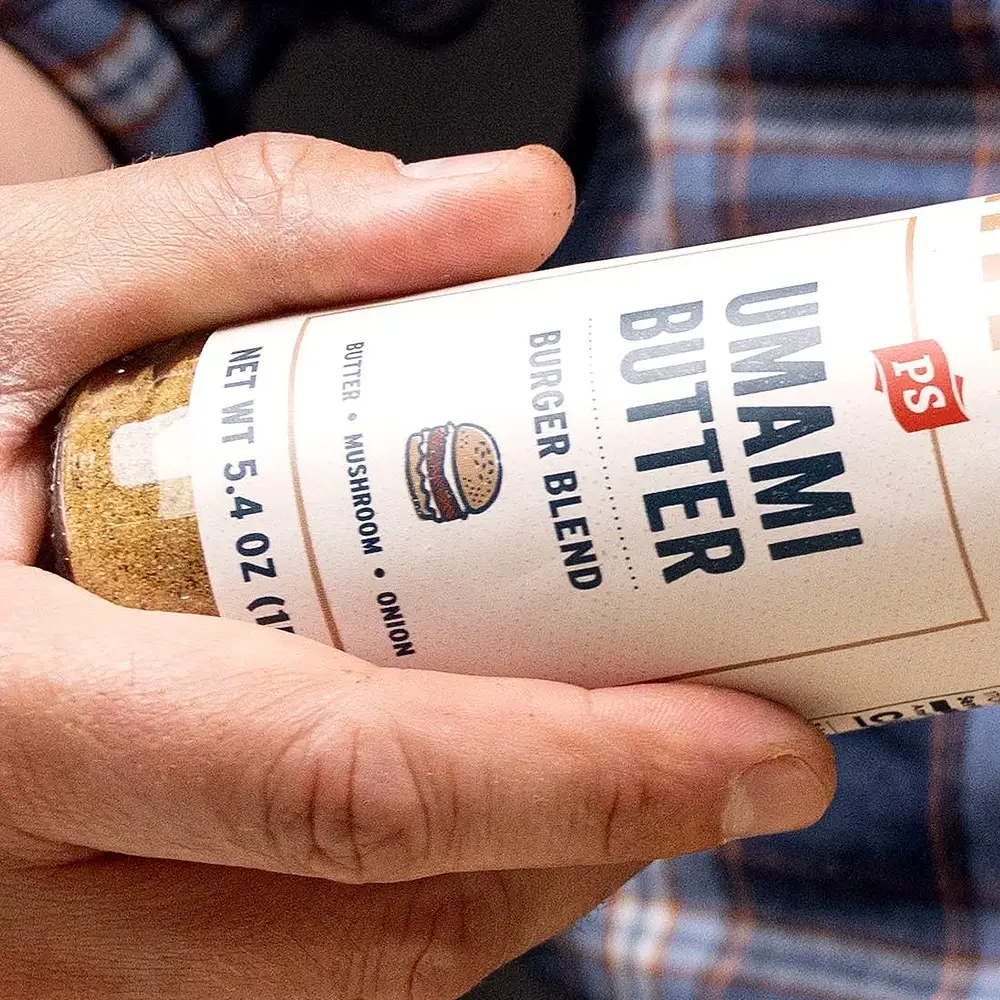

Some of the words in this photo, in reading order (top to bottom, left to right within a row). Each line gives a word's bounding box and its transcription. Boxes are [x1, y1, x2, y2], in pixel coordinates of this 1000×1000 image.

[223, 345, 264, 390] NET
[341, 341, 365, 402] BUTTER
[529, 330, 570, 459] BURGER
[891, 355, 946, 414] PS
[221, 400, 255, 445] WT
[619, 300, 747, 586] BUTTER
[724, 282, 864, 562] UMAMI
[223, 459, 264, 520] 5.4
[344, 433, 384, 556] MUSHROOM
[235, 532, 277, 582] OZ
[543, 470, 603, 591] BLEND
[246, 596, 296, 634] (1
[375, 591, 416, 657] ONION
